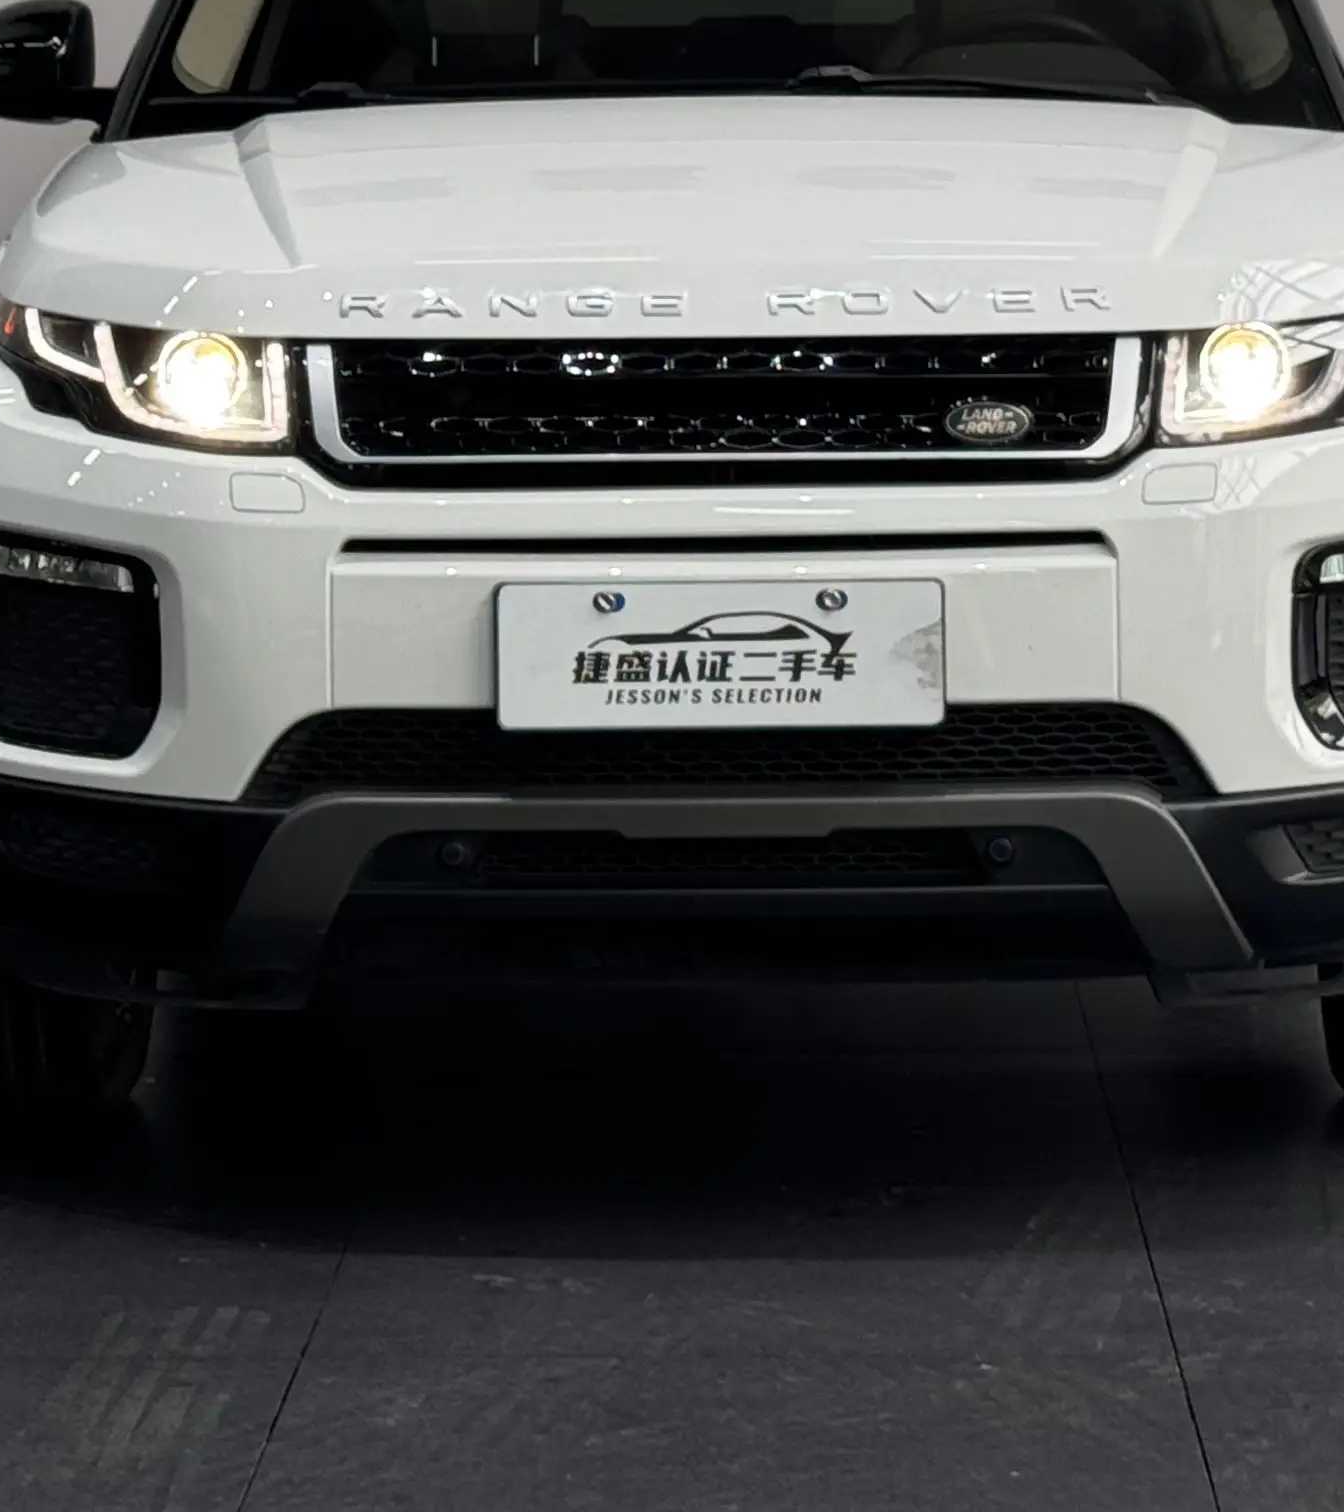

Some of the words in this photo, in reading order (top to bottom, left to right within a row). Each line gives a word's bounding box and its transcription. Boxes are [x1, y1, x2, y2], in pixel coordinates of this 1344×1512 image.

[338, 288, 688, 320] RANGE
[766, 286, 1111, 316] ROVER
[572, 649, 858, 684] 捷盛认证二手车
[604, 688, 703, 705] JESSON'S
[711, 687, 823, 704] SELECTION
